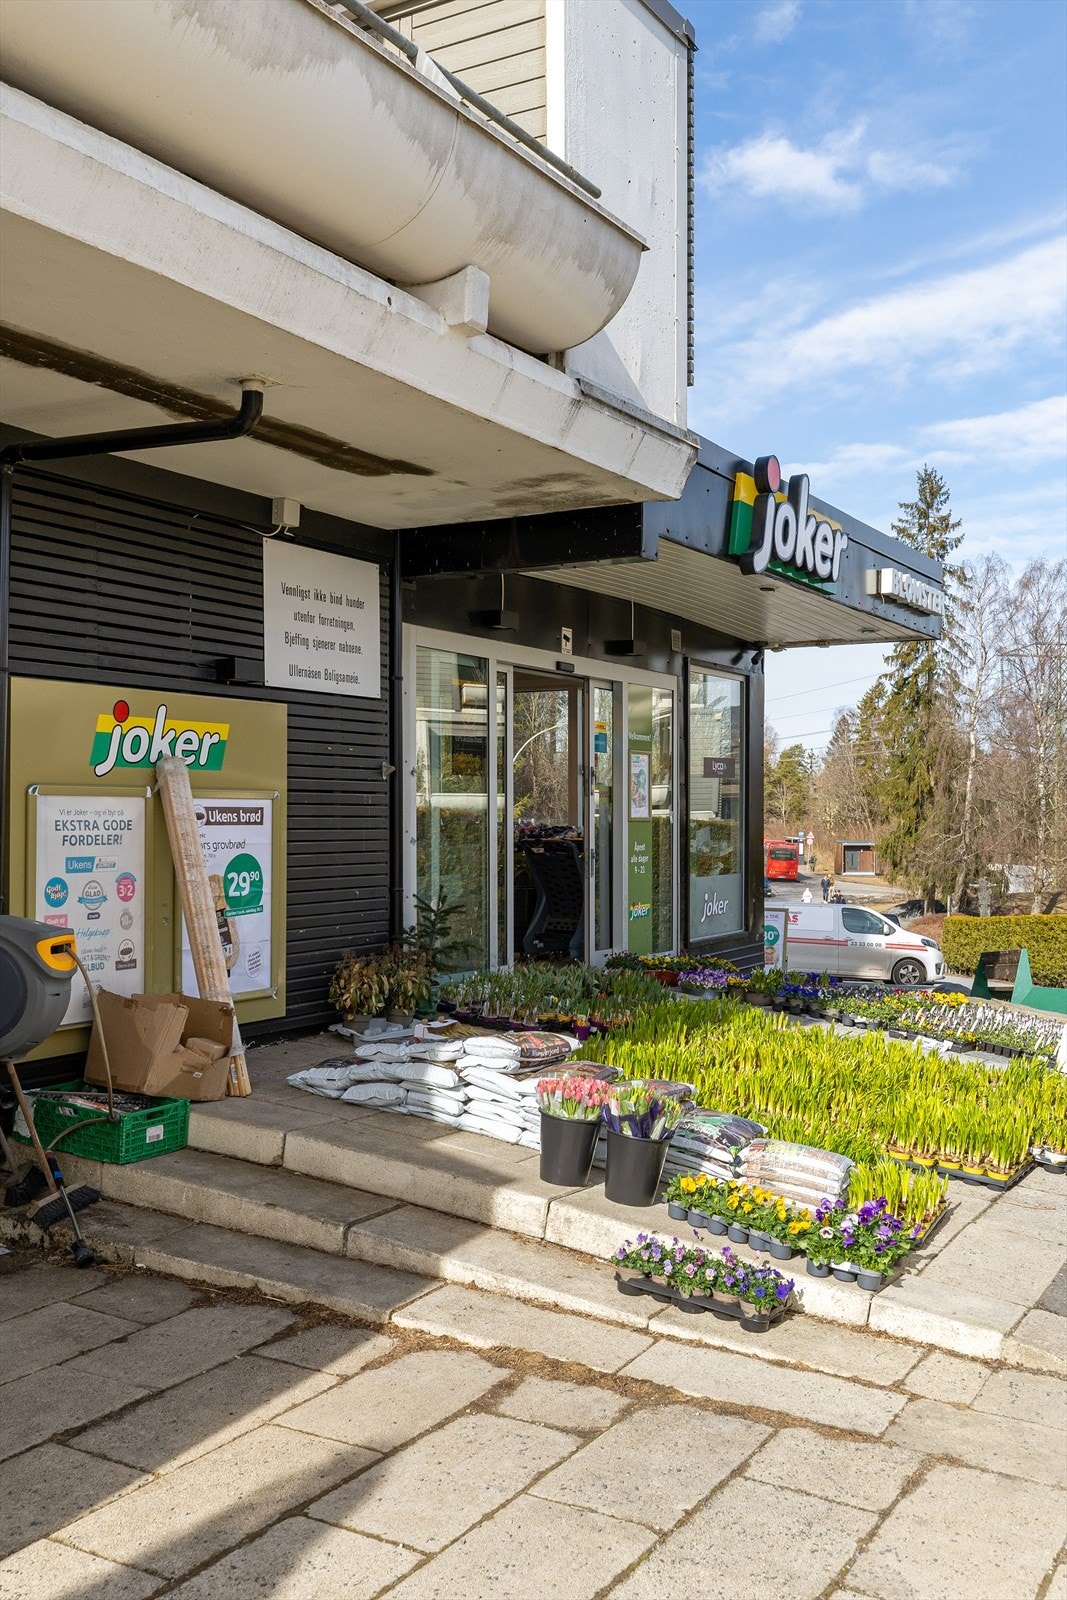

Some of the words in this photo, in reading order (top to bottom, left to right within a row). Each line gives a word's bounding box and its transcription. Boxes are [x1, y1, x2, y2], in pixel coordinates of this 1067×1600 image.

[744, 455, 848, 583] joker
[281, 581, 311, 601] Vennligst
[313, 588, 327, 603] ikke
[329, 591, 343, 606] bind
[345, 594, 365, 610] hunder
[293, 610, 316, 625] utenfor
[318, 612, 356, 632] forretningen.
[284, 631, 309, 650] Bjeffing
[312, 636, 336, 651] sjenerer
[339, 640, 363, 655] naboene.
[288, 663, 322, 680] Ullernåsen
[324, 668, 361, 685] Boligsameie.
[94, 699, 220, 777] joker
[59, 808, 65, 816] Vi
[73, 808, 89, 816] Joker
[93, 809, 101, 817] og
[102, 808, 107, 816] vi
[107, 808, 116, 817] byr
[117, 808, 124, 817] på
[208, 809, 238, 823] Ukens
[239, 809, 261, 823] brød
[54, 819, 100, 832] EKSTRA
[102, 819, 133, 831] GODE
[61, 833, 123, 847] FORDELER!
[212, 838, 246, 852] grovbrød
[68, 859, 92, 870] Ukens
[85, 890, 100, 898] GLAD
[629, 901, 649, 921] joker
[700, 892, 729, 923] joker
